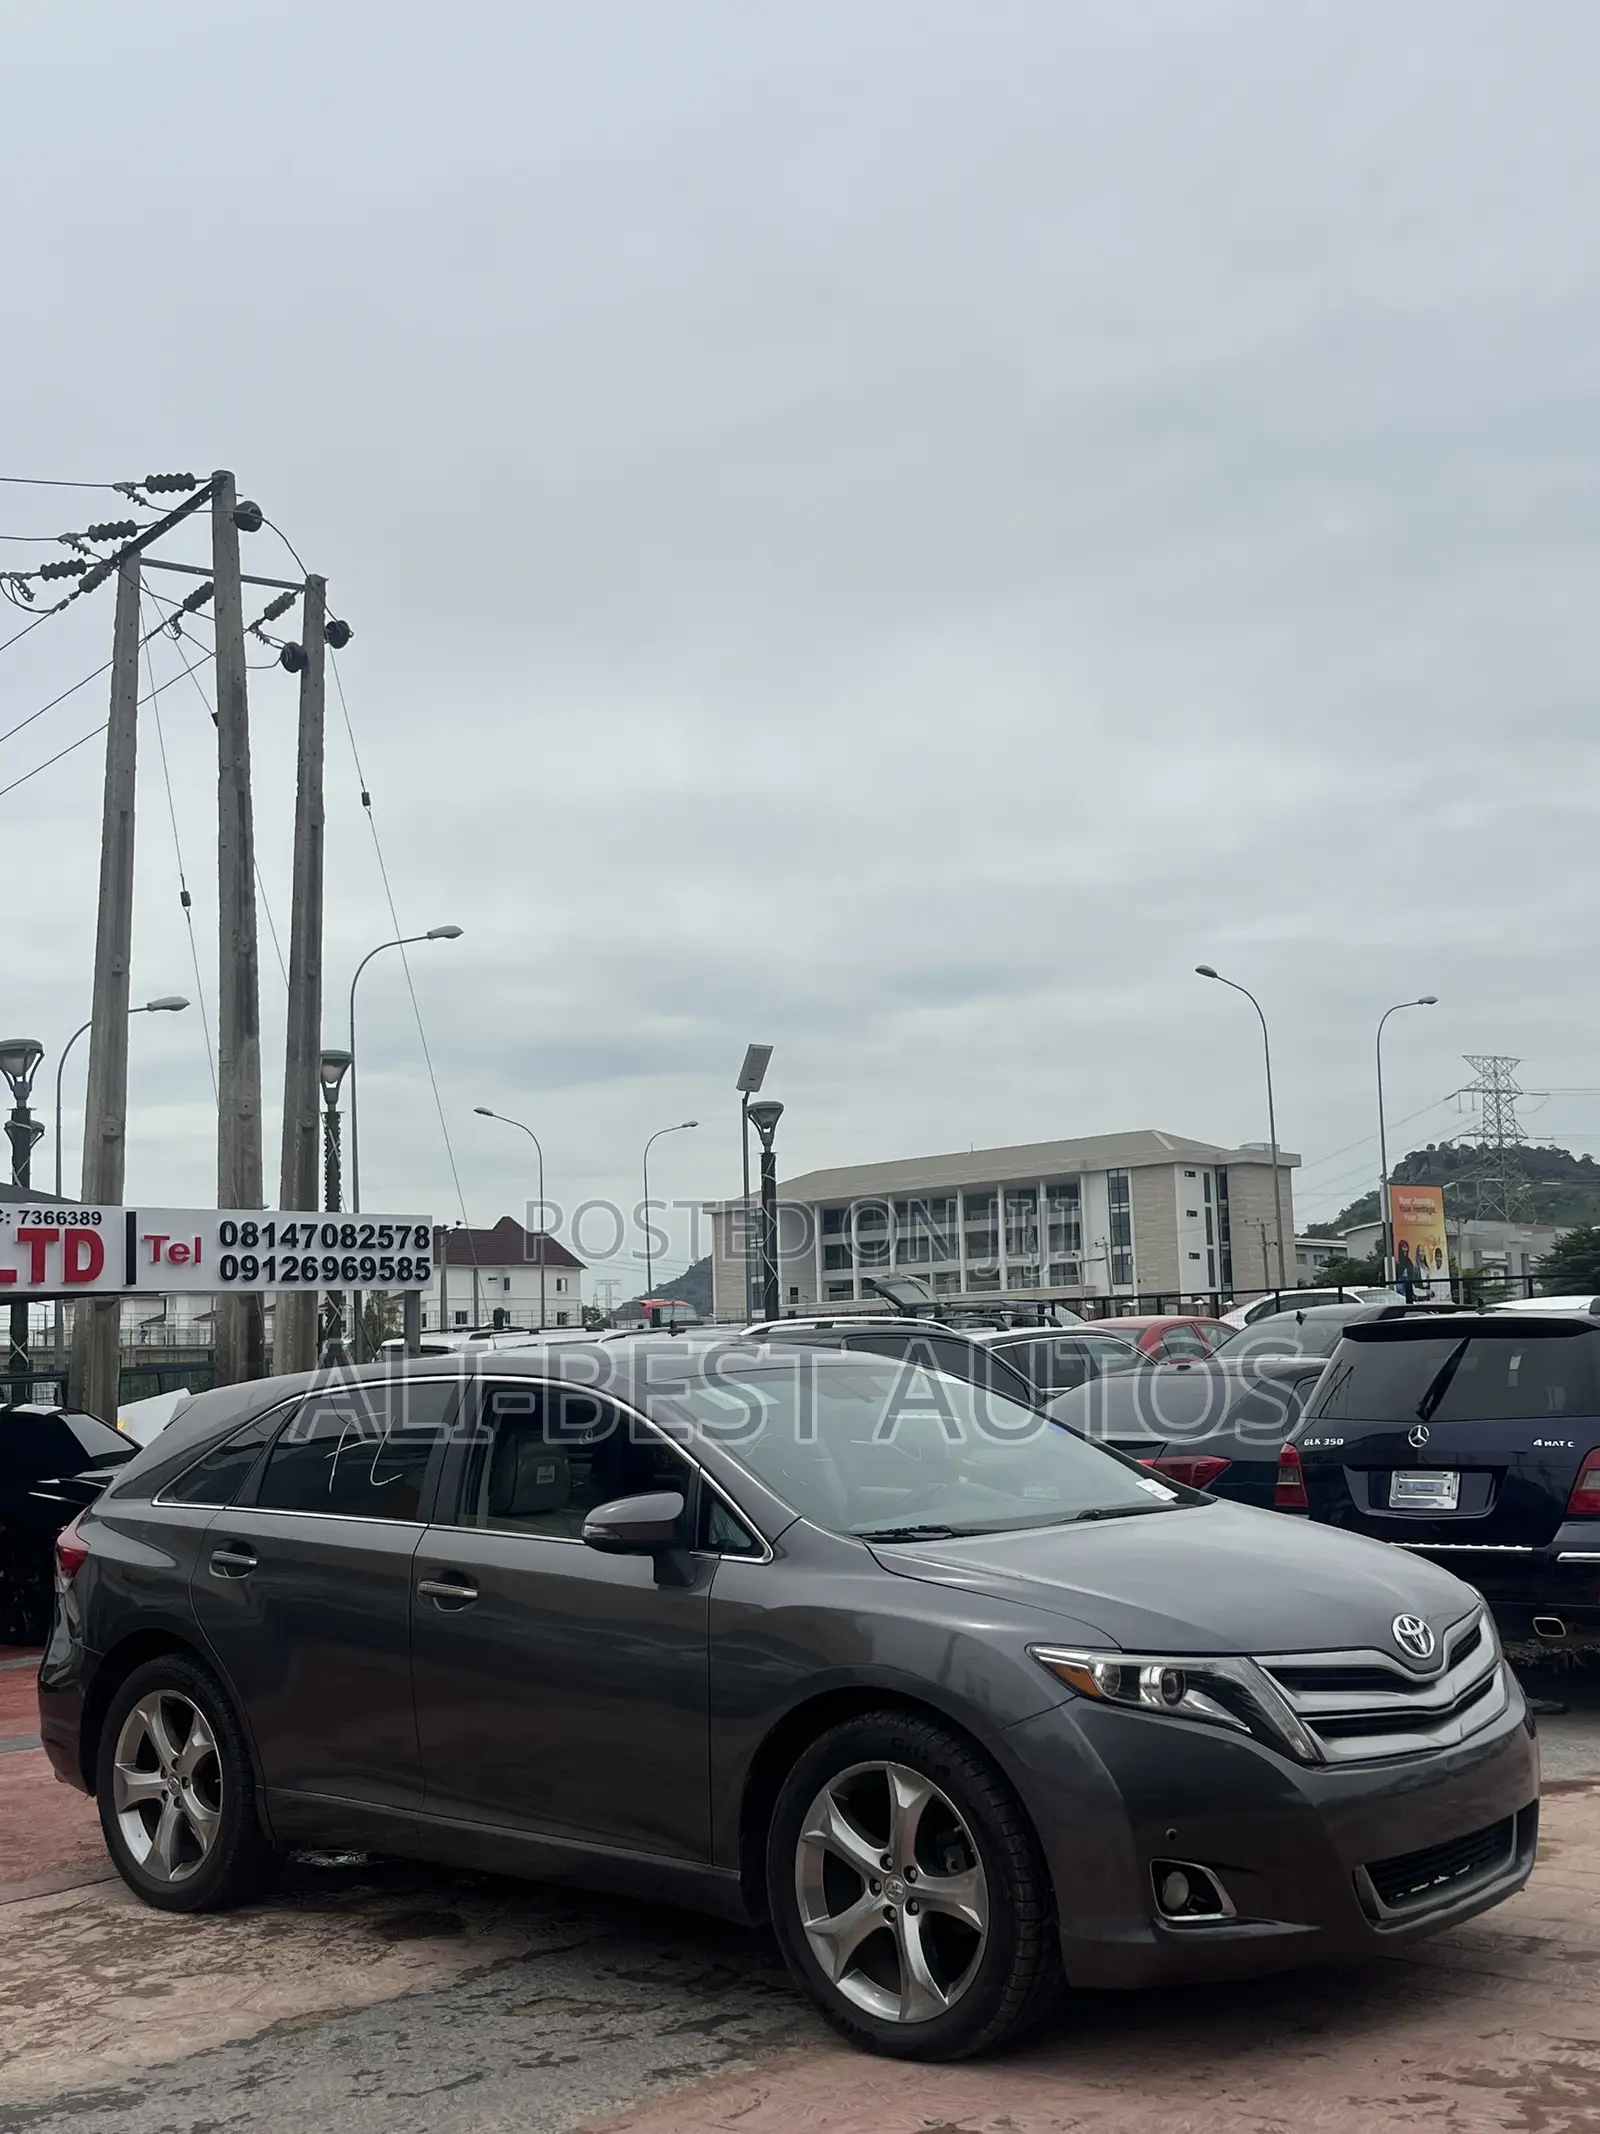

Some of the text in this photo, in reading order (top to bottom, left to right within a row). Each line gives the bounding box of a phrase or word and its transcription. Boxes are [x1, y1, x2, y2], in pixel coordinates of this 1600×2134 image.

[18, 1210, 102, 1226] 7366389
[219, 1220, 431, 1250] 08147082578
[143, 1235, 202, 1264] Tel
[219, 1254, 431, 1282] 09126969585
[1304, 1437, 1344, 1446] GLK 350
